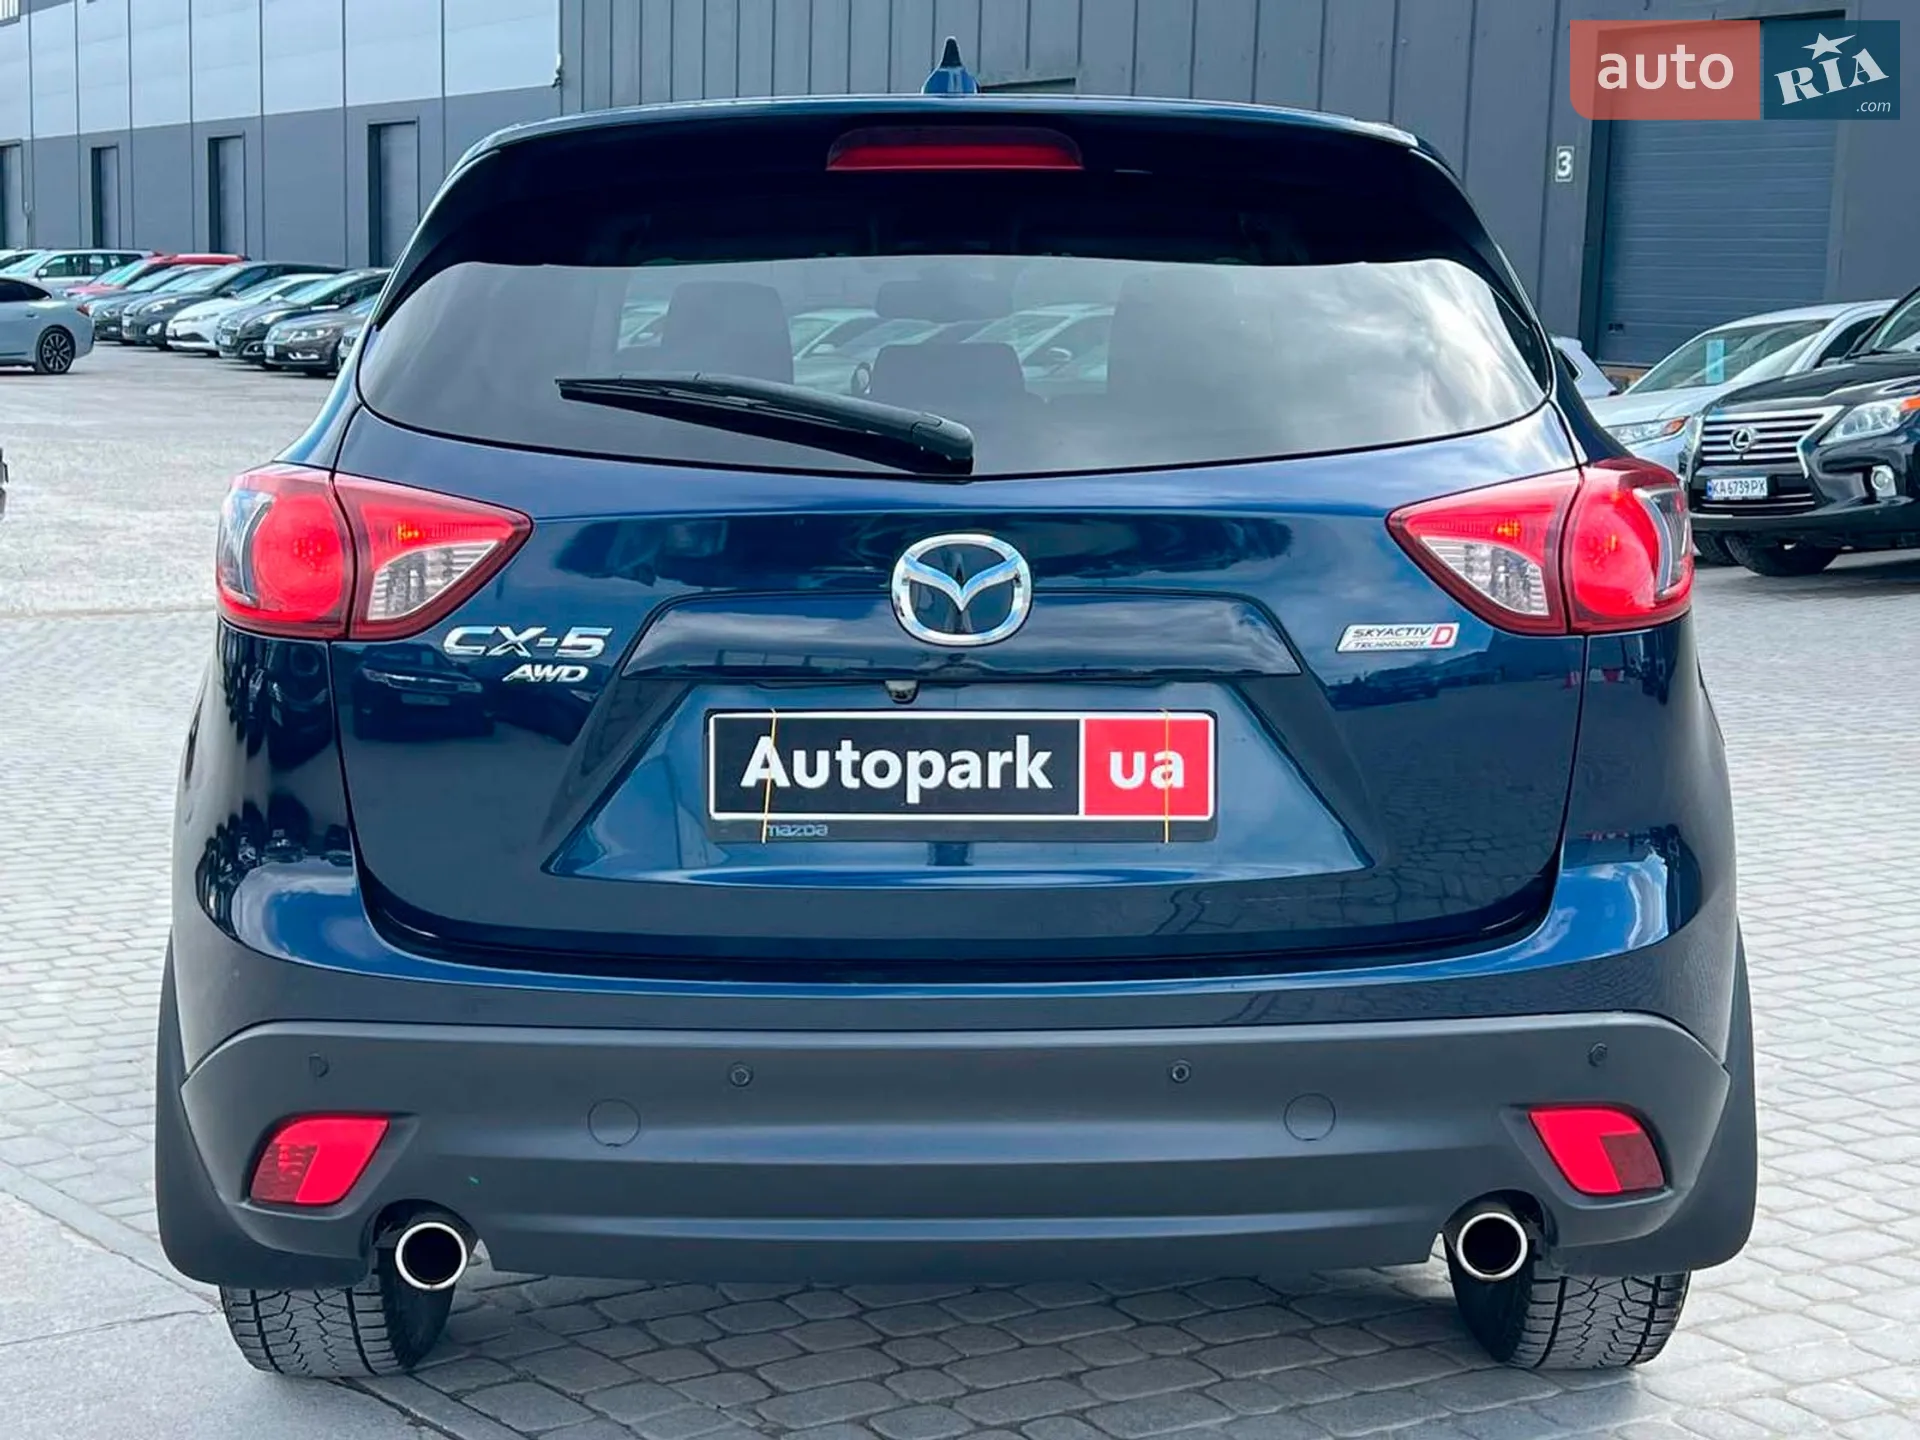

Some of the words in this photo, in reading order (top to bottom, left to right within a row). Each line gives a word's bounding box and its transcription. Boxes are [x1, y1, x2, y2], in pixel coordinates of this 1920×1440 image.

[1557, 150, 1572, 176] 3
[443, 625, 613, 658] CX-5
[1352, 627, 1431, 639] SKYACTIV
[1430, 626, 1455, 645] D
[1352, 639, 1426, 649] TECHNOLOGY
[502, 663, 589, 683] AWD
[740, 735, 1053, 804] Autopark
[1109, 750, 1185, 789] ua
